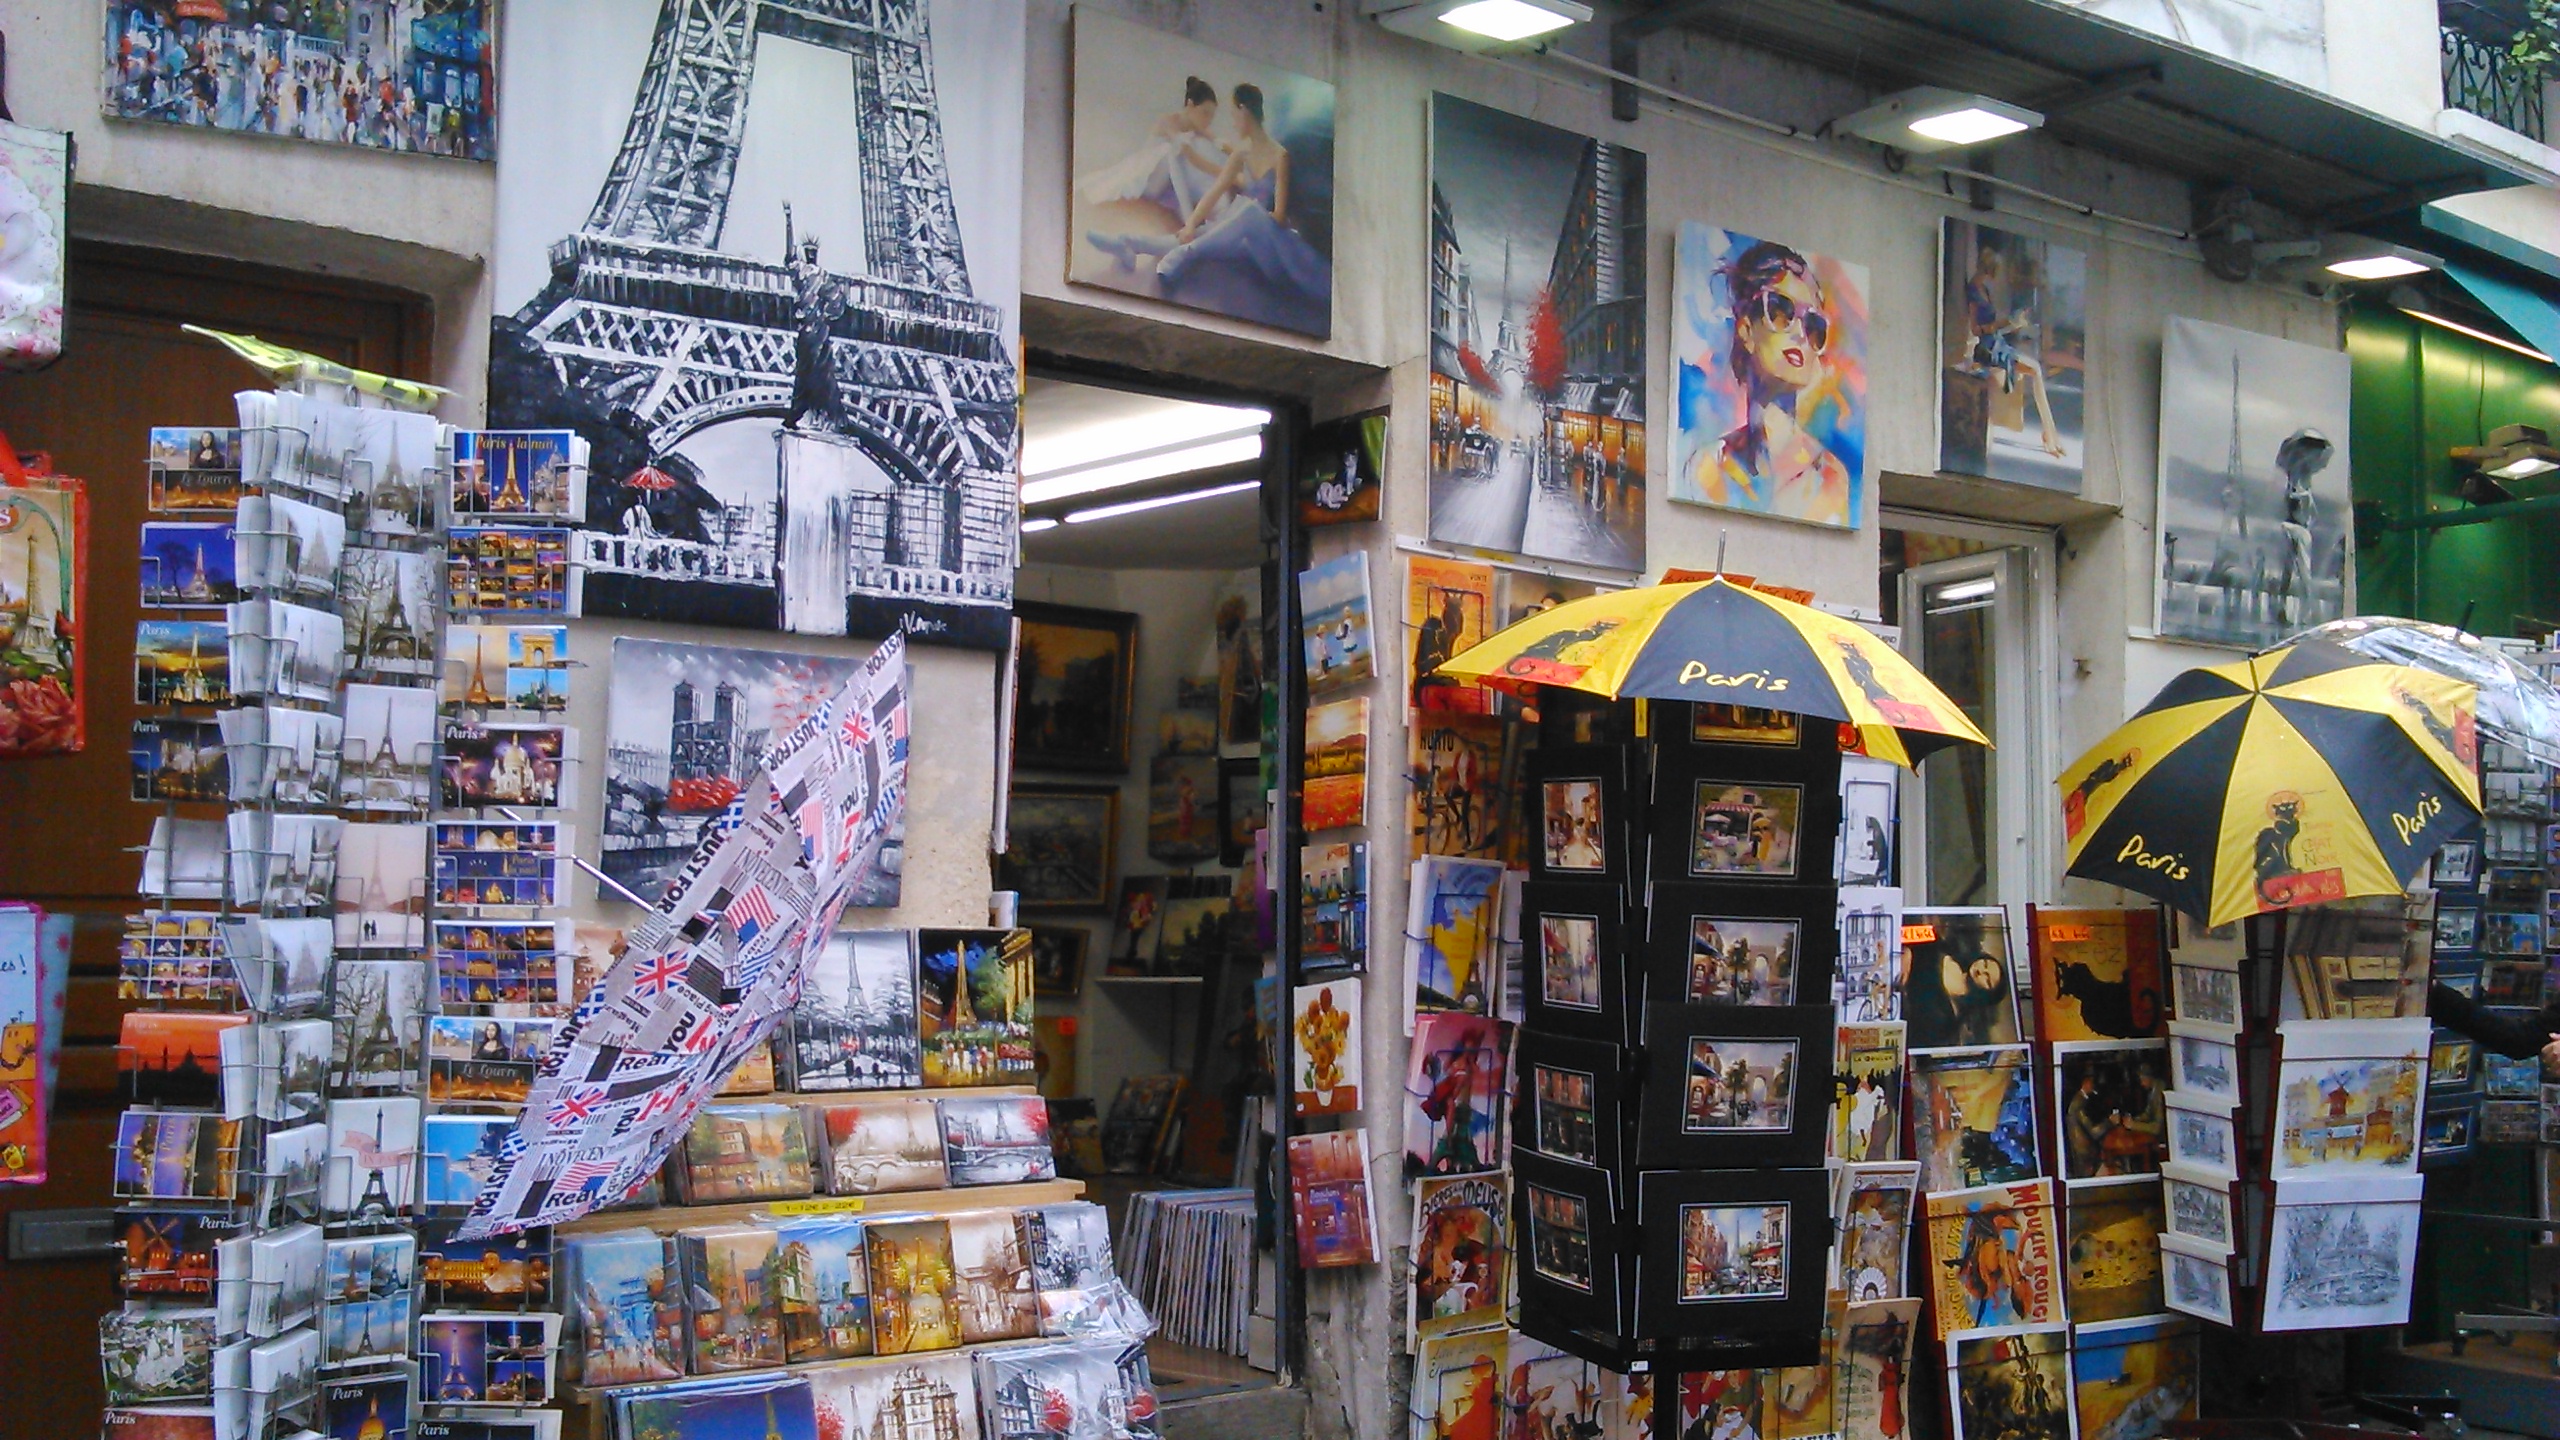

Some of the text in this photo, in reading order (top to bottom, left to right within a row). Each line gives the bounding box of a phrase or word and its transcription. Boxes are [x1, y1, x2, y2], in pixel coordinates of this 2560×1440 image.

[477, 434, 506, 449] Paris
[140, 622, 171, 636] Paris
[1678, 660, 1790, 691] Paris
[133, 720, 160, 733] Paris
[447, 726, 479, 740] Paris
[769, 717, 821, 771] JUST FOR
[2391, 791, 2442, 847] Paris
[656, 829, 731, 915] JUST FOR
[2116, 833, 2190, 881] Paris
[662, 1010, 697, 1053] YOU
[539, 1049, 570, 1079] FOR
[611, 1106, 641, 1138] YOU
[471, 1159, 516, 1218] JUST FOR
[200, 1216, 231, 1229] Paris
[2006, 1184, 2048, 1260] MOULIN
[332, 1386, 363, 1400] Paris
[105, 1411, 136, 1424] Paris
[417, 1421, 450, 1436] Paris
